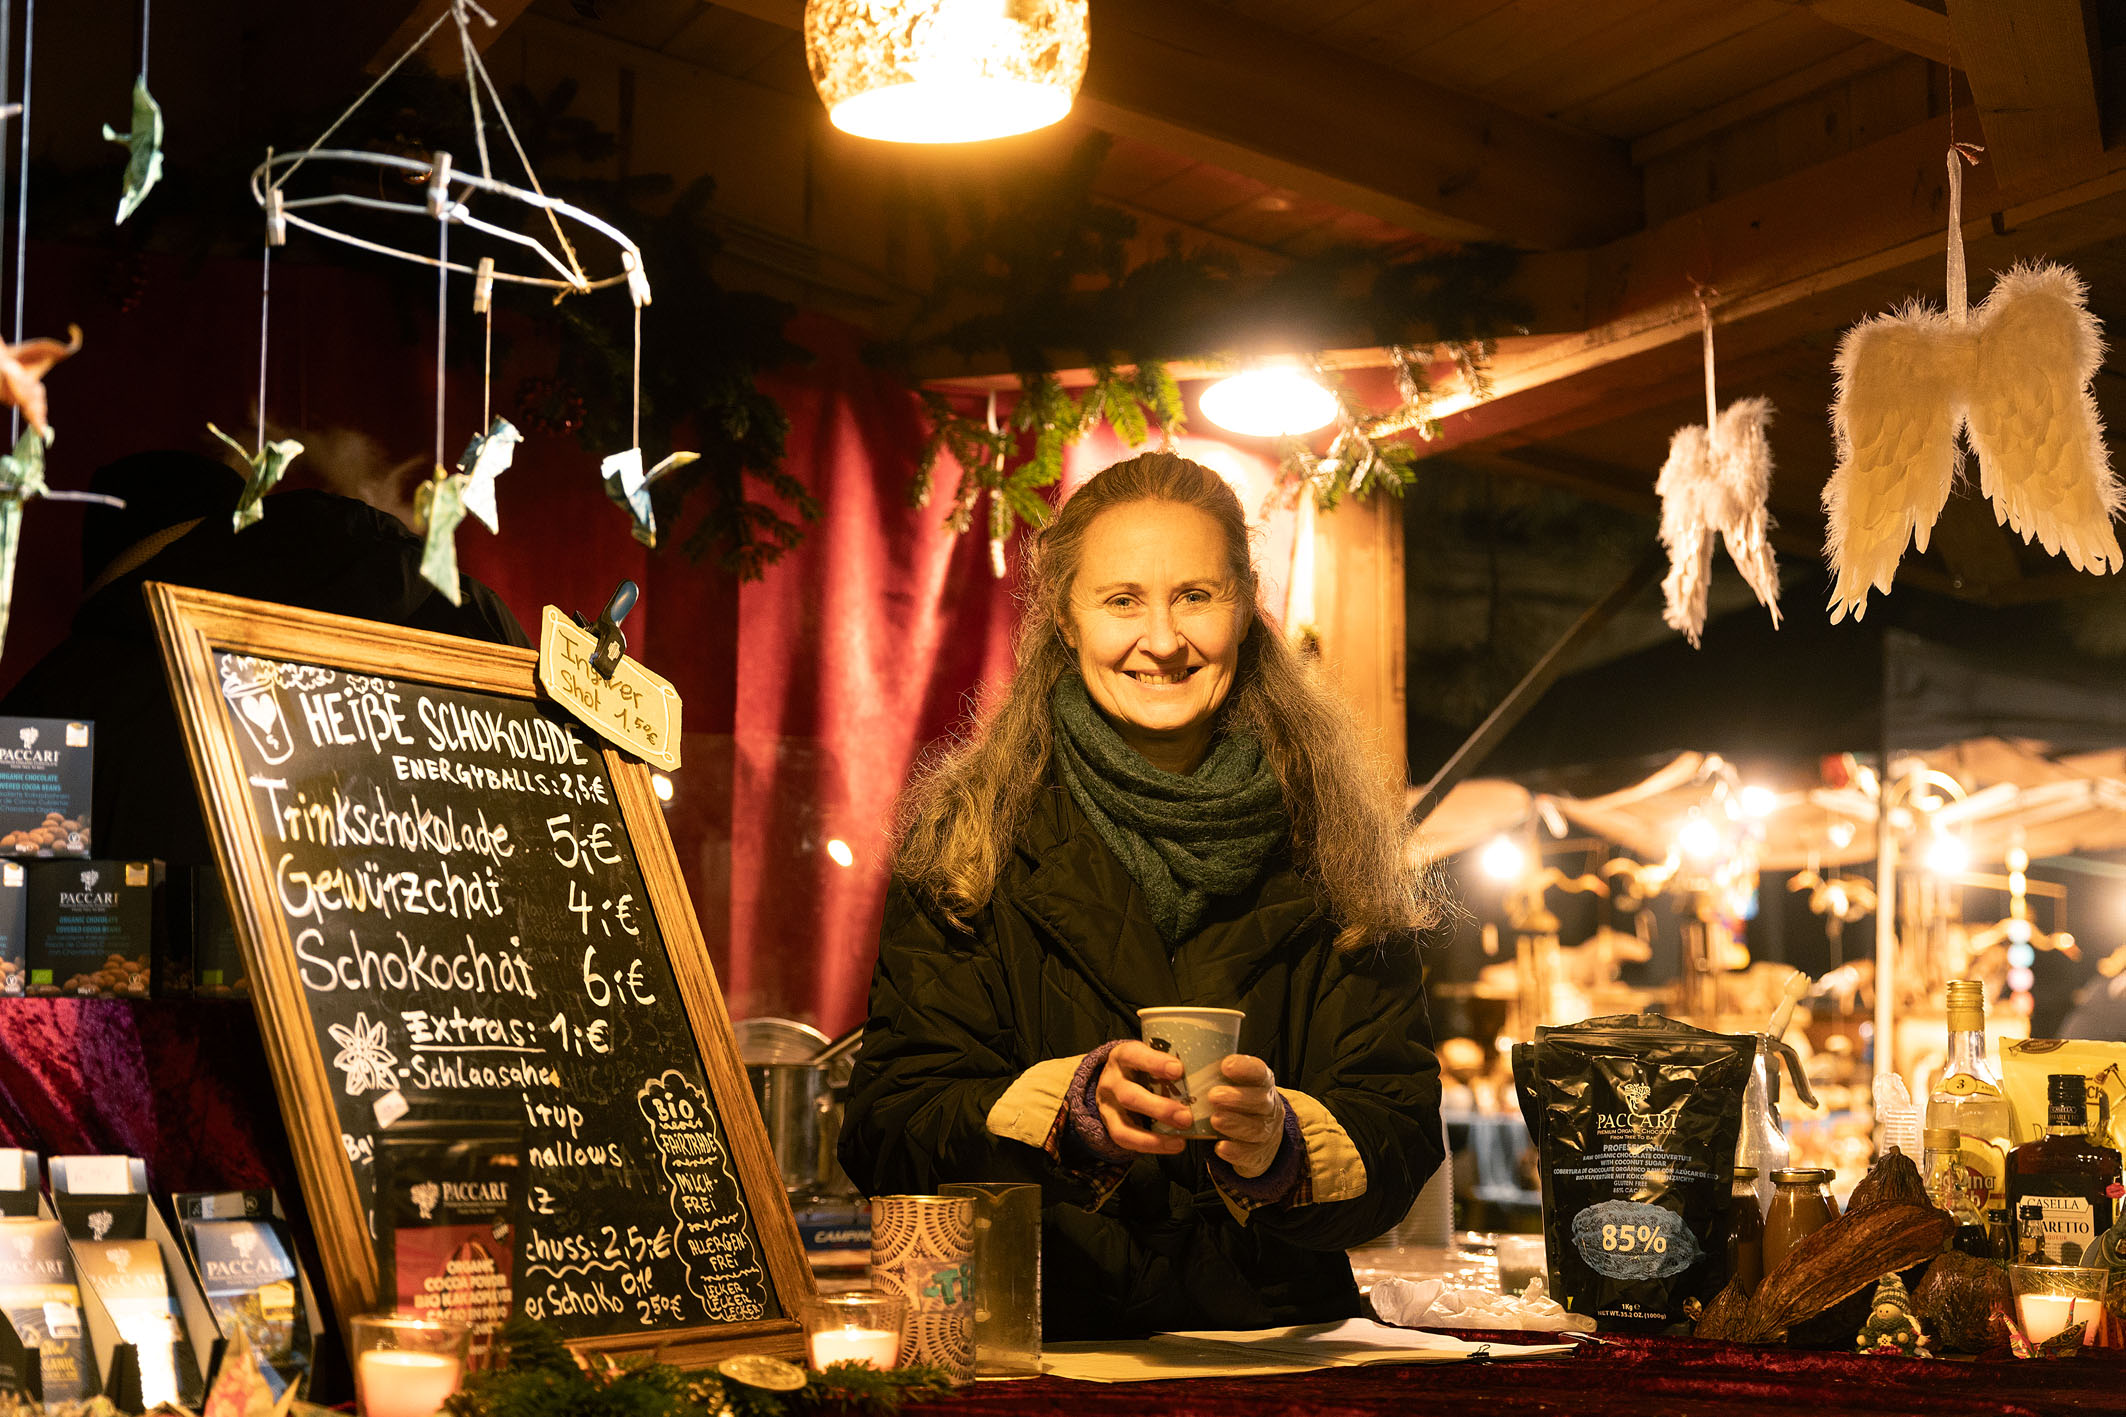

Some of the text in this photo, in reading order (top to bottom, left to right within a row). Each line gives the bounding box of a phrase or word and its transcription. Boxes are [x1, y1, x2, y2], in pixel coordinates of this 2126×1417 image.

[560, 670, 601, 711] Shot
[417, 695, 588, 766] SCHOKOLADE
[0, 749, 59, 762] PACCARI
[392, 755, 560, 796] ENERGYBALLS:
[249, 773, 515, 867] Trinkschokolade
[60, 892, 119, 904] PACCARI
[277, 852, 503, 924] Gewürzchai
[296, 928, 537, 1000] Schokochai
[401, 1006, 537, 1047] Extras:
[1956, 1080, 1965, 1089] 3
[522, 1092, 584, 1140] irup
[1597, 1112, 1677, 1130] PACCARI
[442, 1181, 508, 1200] PACCARI
[2027, 1198, 2079, 1209] CASELLA
[1602, 1224, 1667, 1253] 85%
[2042, 1221, 2090, 1234] ARETTO
[1, 1259, 64, 1274] ACCARI
[546, 1281, 624, 1316] Schoko
